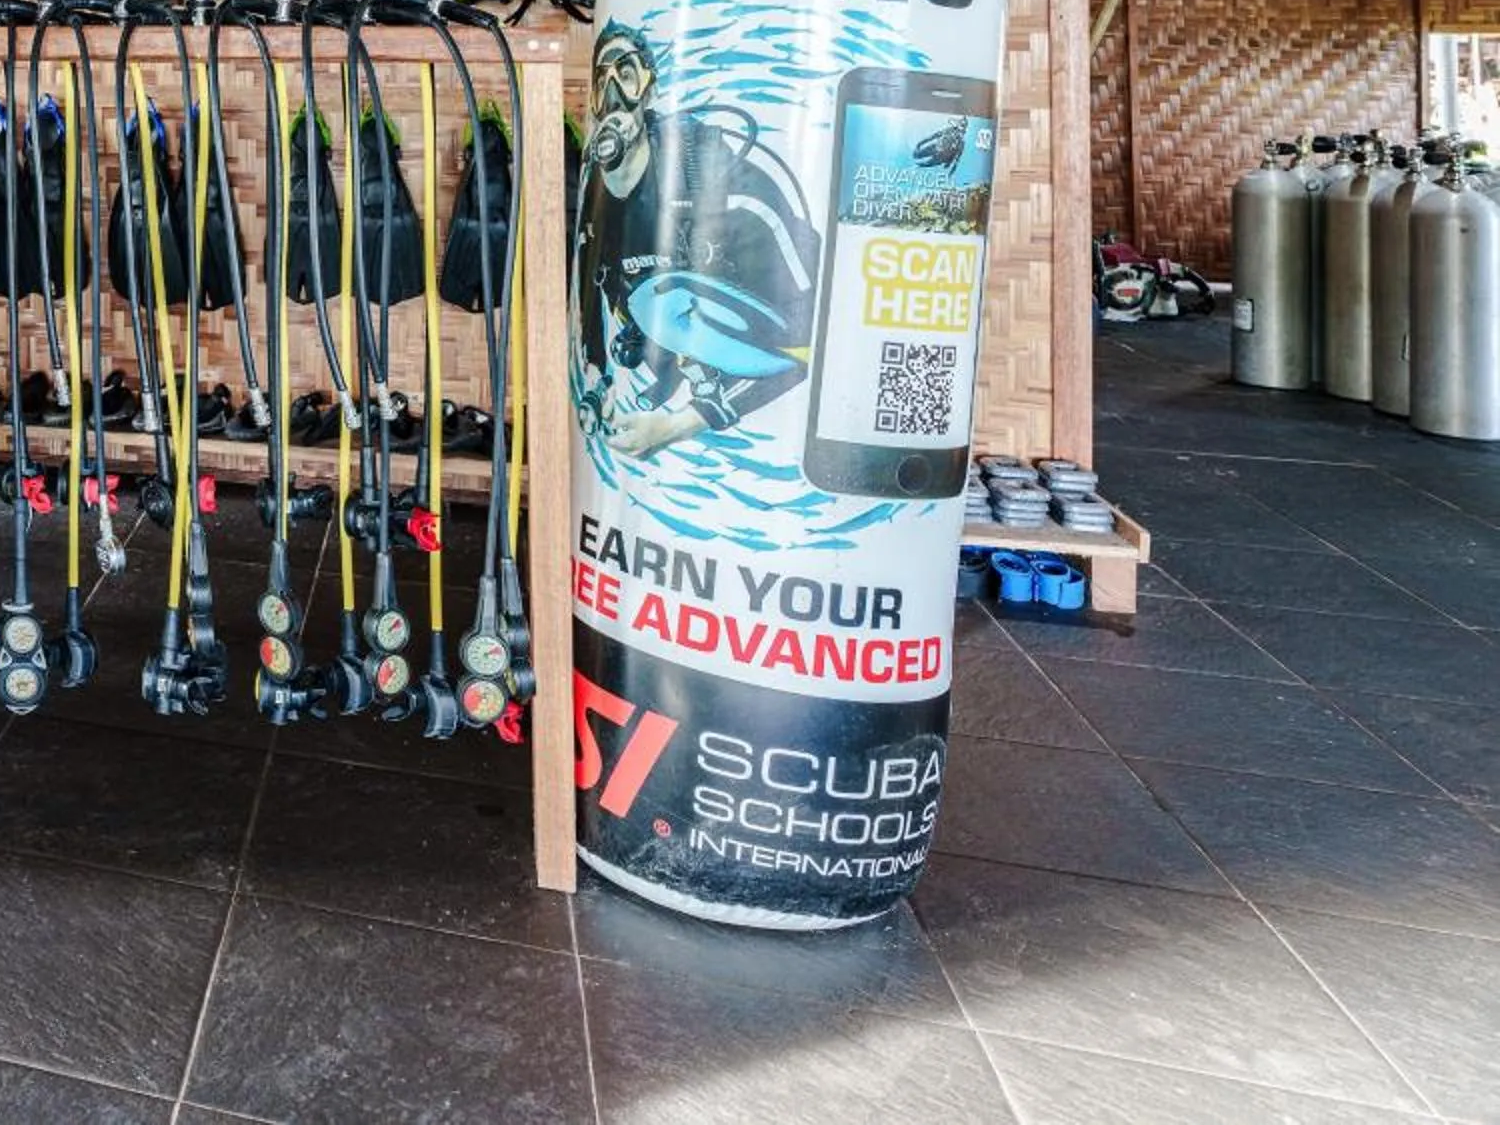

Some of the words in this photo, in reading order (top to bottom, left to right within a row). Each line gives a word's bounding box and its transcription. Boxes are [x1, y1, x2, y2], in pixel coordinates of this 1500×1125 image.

[868, 244, 975, 284] SCAN
[872, 285, 969, 326] HERE
[579, 512, 718, 602] EARN
[737, 564, 904, 630] YOUR
[572, 555, 621, 621] EE
[631, 592, 942, 685] ADVANCED
[696, 730, 942, 801] SCUBA
[692, 785, 940, 846] SCHOOLS
